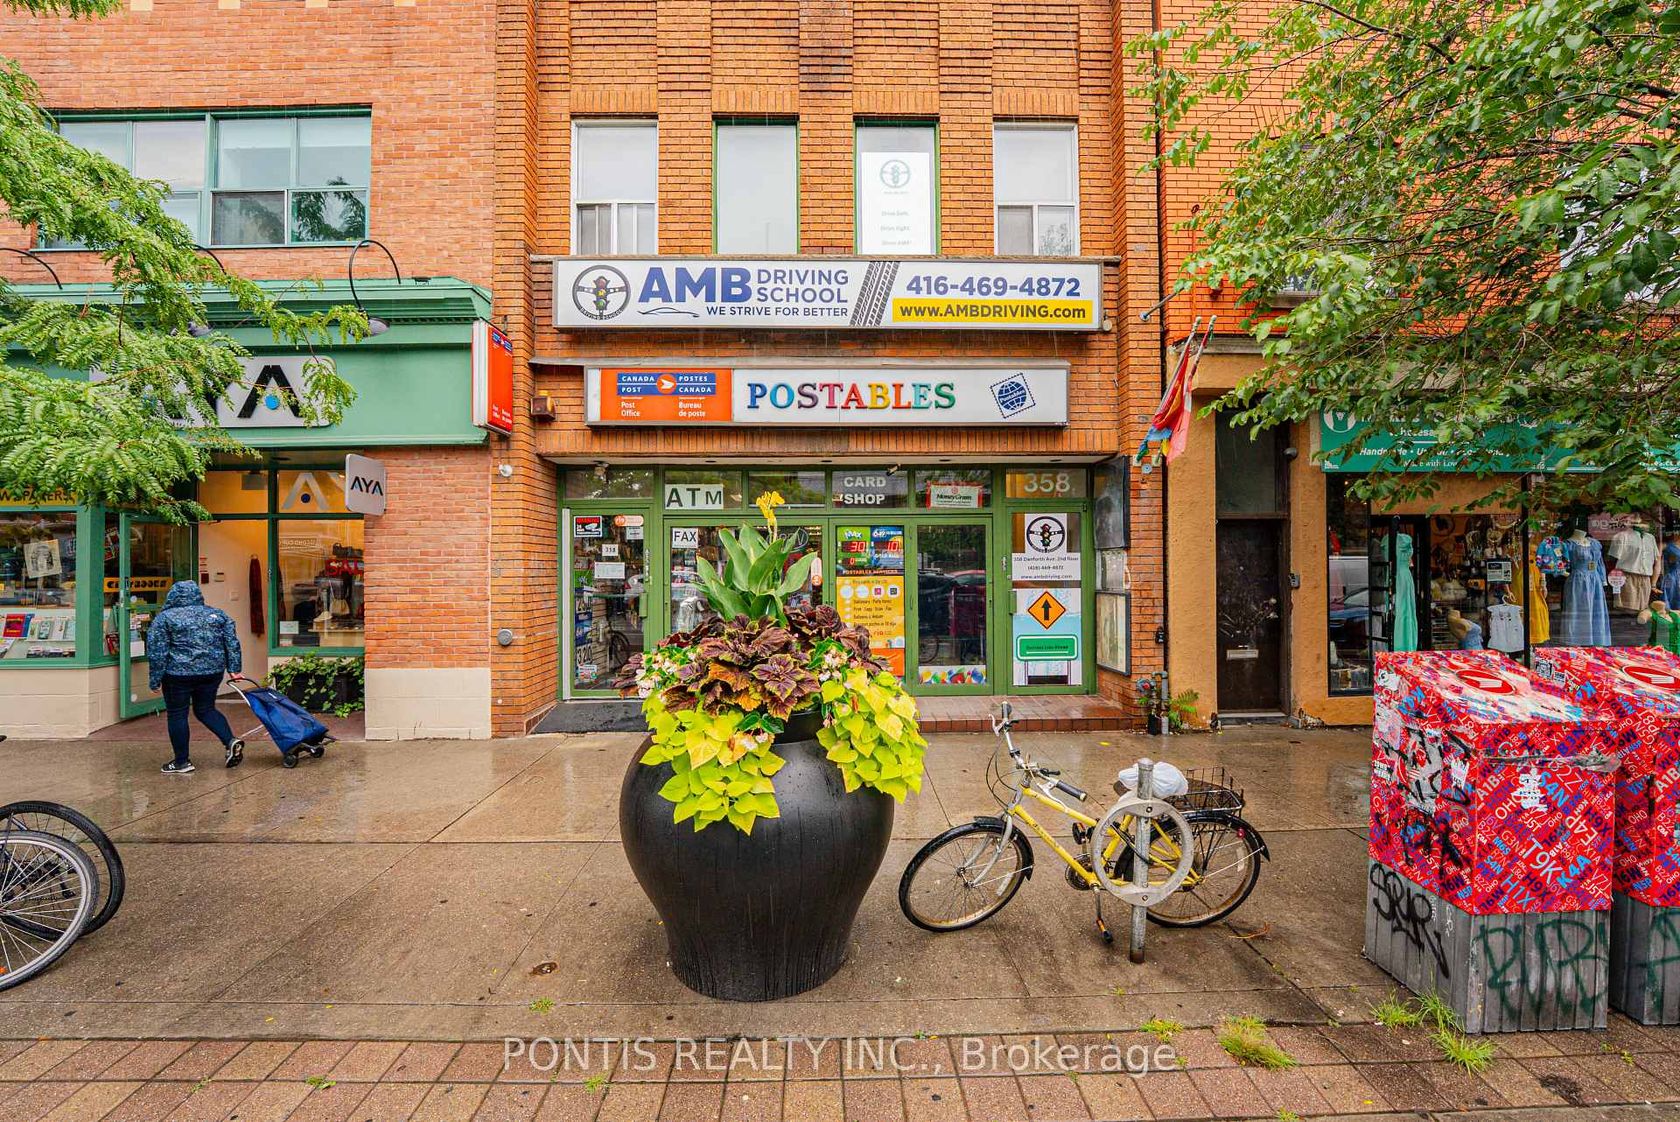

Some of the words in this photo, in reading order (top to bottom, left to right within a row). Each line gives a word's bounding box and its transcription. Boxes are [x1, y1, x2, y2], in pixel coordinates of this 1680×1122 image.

[638, 266, 752, 303] AMB
[757, 269, 849, 285] DRIVING
[906, 275, 1081, 297] 416-469-4872
[756, 287, 848, 303] SCHOOL
[706, 306, 726, 316] WE
[729, 306, 771, 316] STRIVE
[775, 307, 800, 316] FOR
[803, 307, 848, 317] BETTER
[900, 304, 1086, 319] www.AMBDRIVING.com
[747, 383, 956, 409] POSTABLES
[621, 401, 635, 409] Post
[678, 401, 702, 409] Bureau
[688, 410, 706, 418] poste
[351, 475, 384, 496] AYA
[844, 476, 886, 488] CARD
[1024, 473, 1070, 492] 358
[666, 488, 722, 507] ATM
[844, 494, 885, 505] SHOP
[674, 531, 696, 542] FAX
[850, 541, 866, 552] 30
[887, 541, 899, 552] 10
[1475, 775, 1500, 799] A1B
[1535, 771, 1569, 805] S4N
[1477, 821, 1496, 840] B2Z
[1524, 816, 1540, 832] J5T
[1563, 811, 1596, 843] E4P
[1500, 830, 1522, 851] G3N
[1520, 840, 1562, 881] T9K
[1584, 846, 1602, 863] X1A
[1485, 855, 1503, 873] S4N
[1556, 854, 1591, 886] K4A
[1501, 875, 1534, 908] H1X
[1586, 882, 1602, 898] J5T
